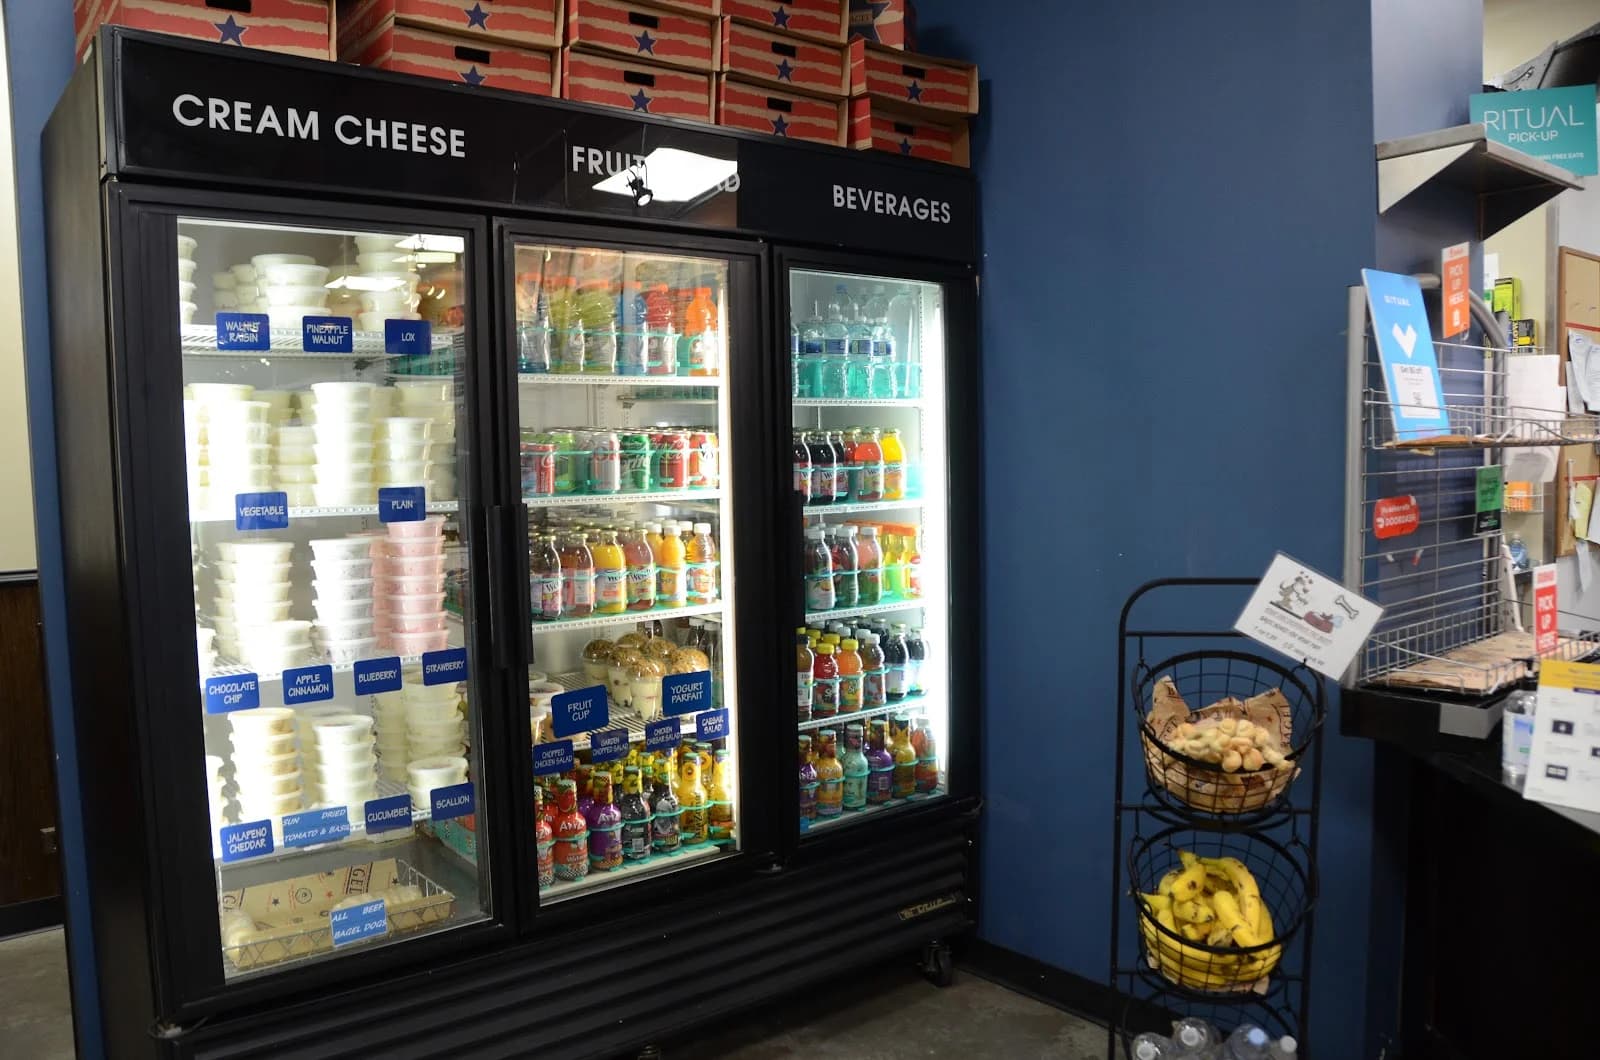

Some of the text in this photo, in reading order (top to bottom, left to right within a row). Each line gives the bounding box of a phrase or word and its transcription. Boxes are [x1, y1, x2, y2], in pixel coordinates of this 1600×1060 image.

[1484, 104, 1585, 131] RITUAL
[172, 94, 465, 158] CREAM CHEESE
[1508, 130, 1558, 143] PICK-UP
[833, 184, 951, 224] BEVERAGES
[225, 321, 260, 333] WALNUT
[306, 324, 349, 335] PINEAPPLE
[229, 332, 259, 343] RAISIN
[312, 335, 344, 345] WALNUT
[401, 332, 416, 342] LOX
[239, 506, 285, 517] VEGETABLE
[391, 500, 413, 510] PLAIN
[1538, 595, 1554, 612] PICK
[1541, 614, 1551, 630] UP
[425, 660, 465, 674] STRAWBERRY
[295, 674, 320, 685] APPLE
[358, 669, 398, 683] BLUEBERRY
[209, 681, 256, 695] CHOCOLATE
[288, 684, 329, 697] CINNAMON
[670, 682, 704, 694] YOGURT
[223, 694, 243, 704] CHIP
[671, 691, 704, 704] PARFAIT
[567, 699, 593, 713] FRUIT
[572, 710, 590, 721] CUP
[653, 726, 672, 736] CHICKEN
[665, 732, 681, 741] SALAD
[704, 725, 722, 735] SALAD
[600, 736, 620, 746] GARDEN
[541, 748, 565, 759] CHOPPED
[592, 743, 629, 756] CHOPPED SALAD
[534, 755, 573, 769] CHICKEN SALAD
[435, 795, 470, 809] SCALLION
[282, 809, 346, 826] SUN DRIED
[367, 807, 410, 822] CUCUMBER
[227, 827, 267, 844] JALAPENO
[284, 830, 319, 842] TOMATO
[229, 839, 266, 854] CHEDDAR
[331, 903, 385, 922] ALL BEEF
[333, 918, 388, 939] BAGEL DOGS
